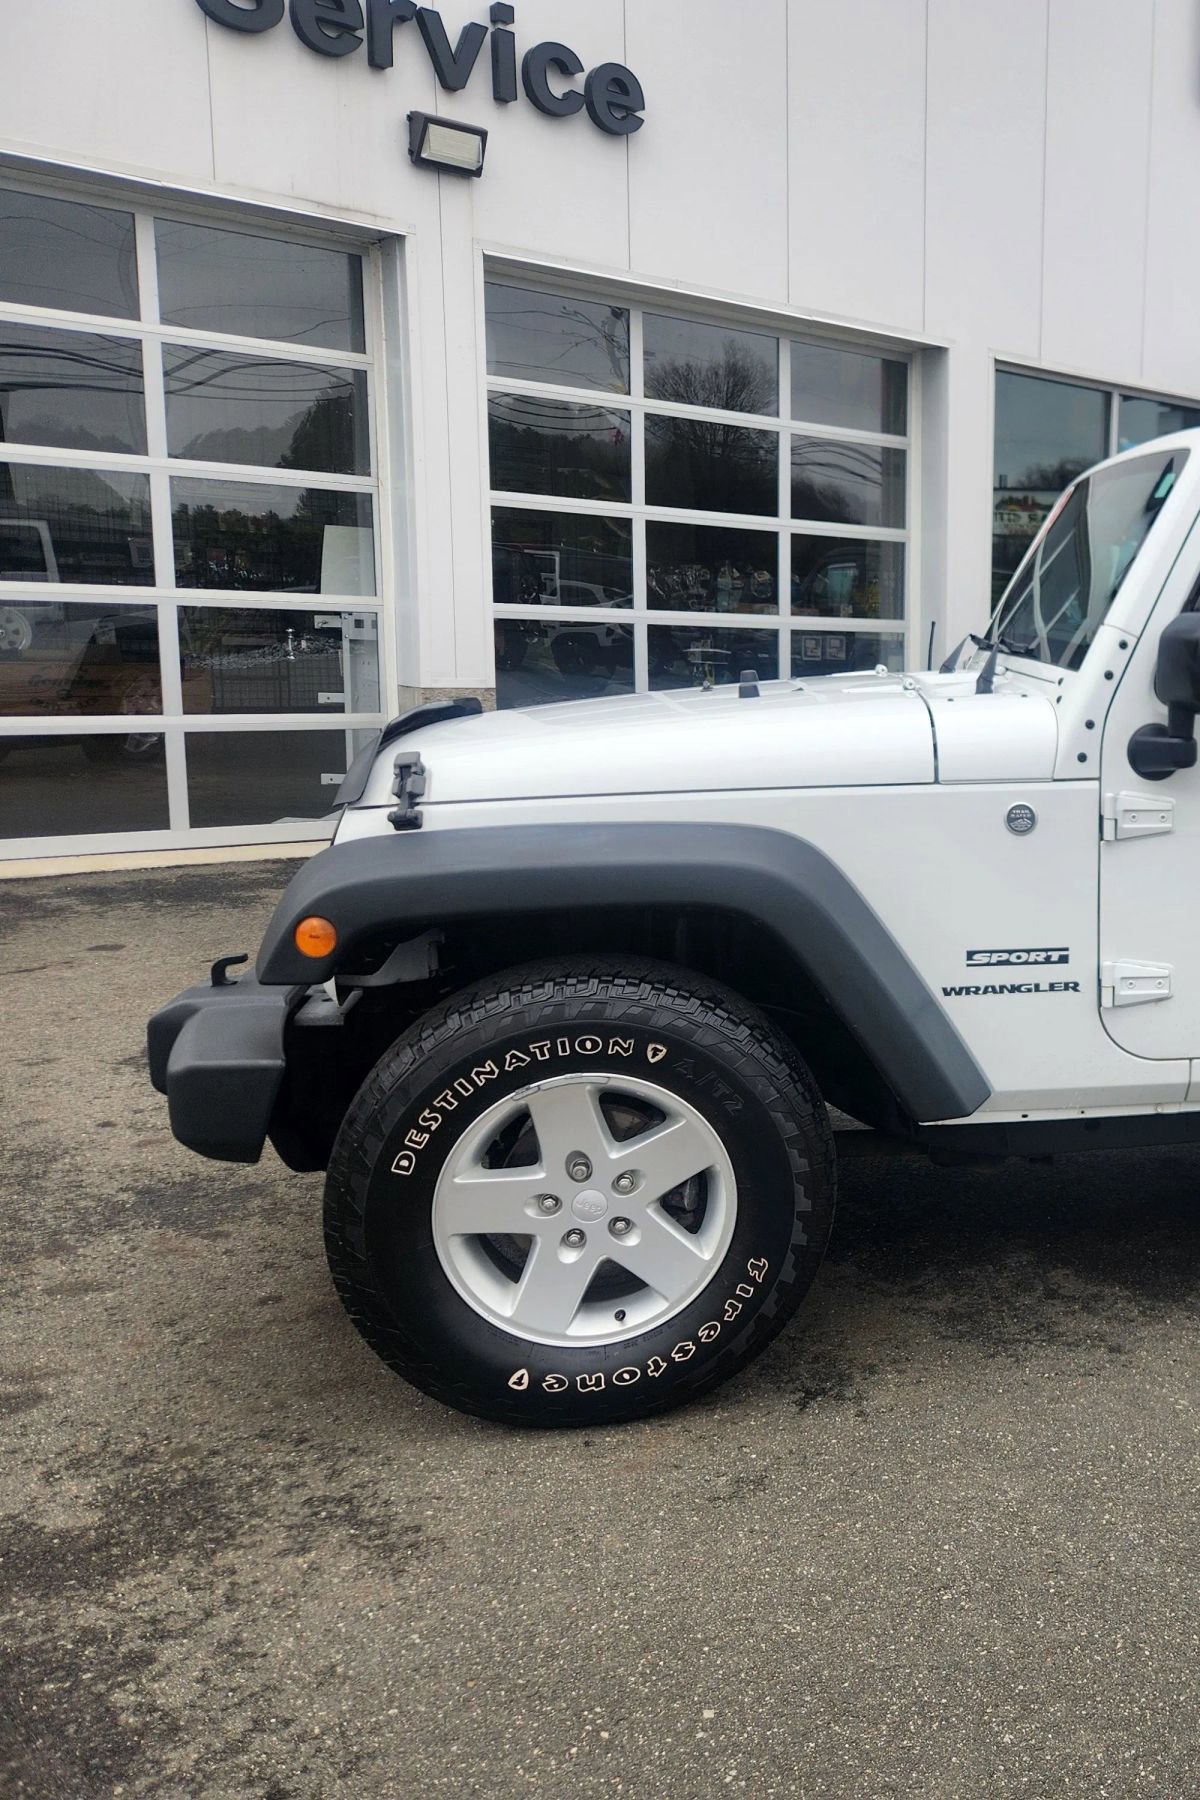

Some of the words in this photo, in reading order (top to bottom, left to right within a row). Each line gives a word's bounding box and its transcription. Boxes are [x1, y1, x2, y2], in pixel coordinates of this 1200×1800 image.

[942, 981, 1081, 997] WRANGLER
[968, 949, 1069, 966] SPORT
[391, 1035, 634, 1176] DESTINATION
[542, 1257, 768, 1392] Firestone
